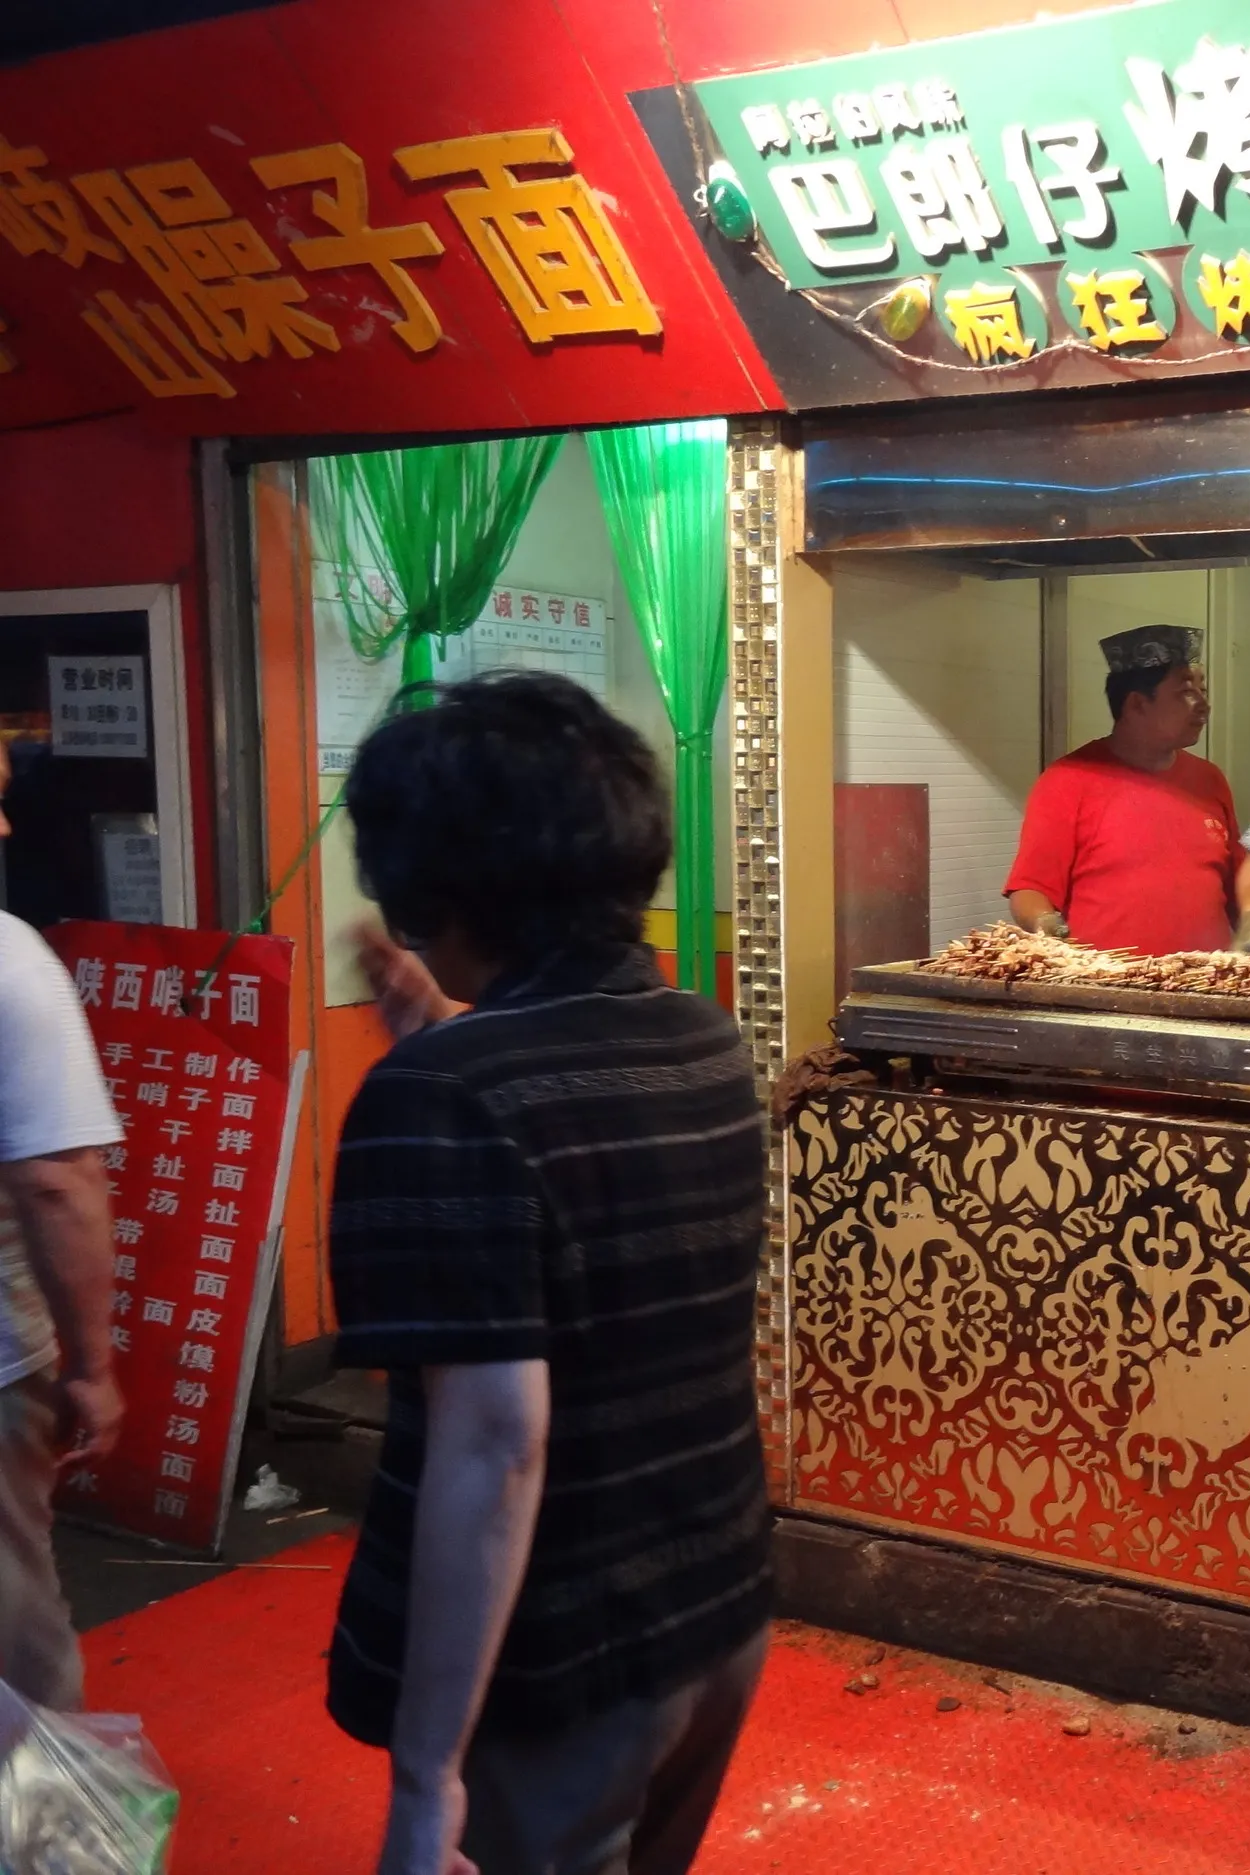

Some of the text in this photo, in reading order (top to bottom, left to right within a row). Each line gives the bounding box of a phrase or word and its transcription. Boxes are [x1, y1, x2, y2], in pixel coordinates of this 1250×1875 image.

[493, 589, 591, 628] 诚实守信
[102, 1042, 262, 1084] 手工制作
